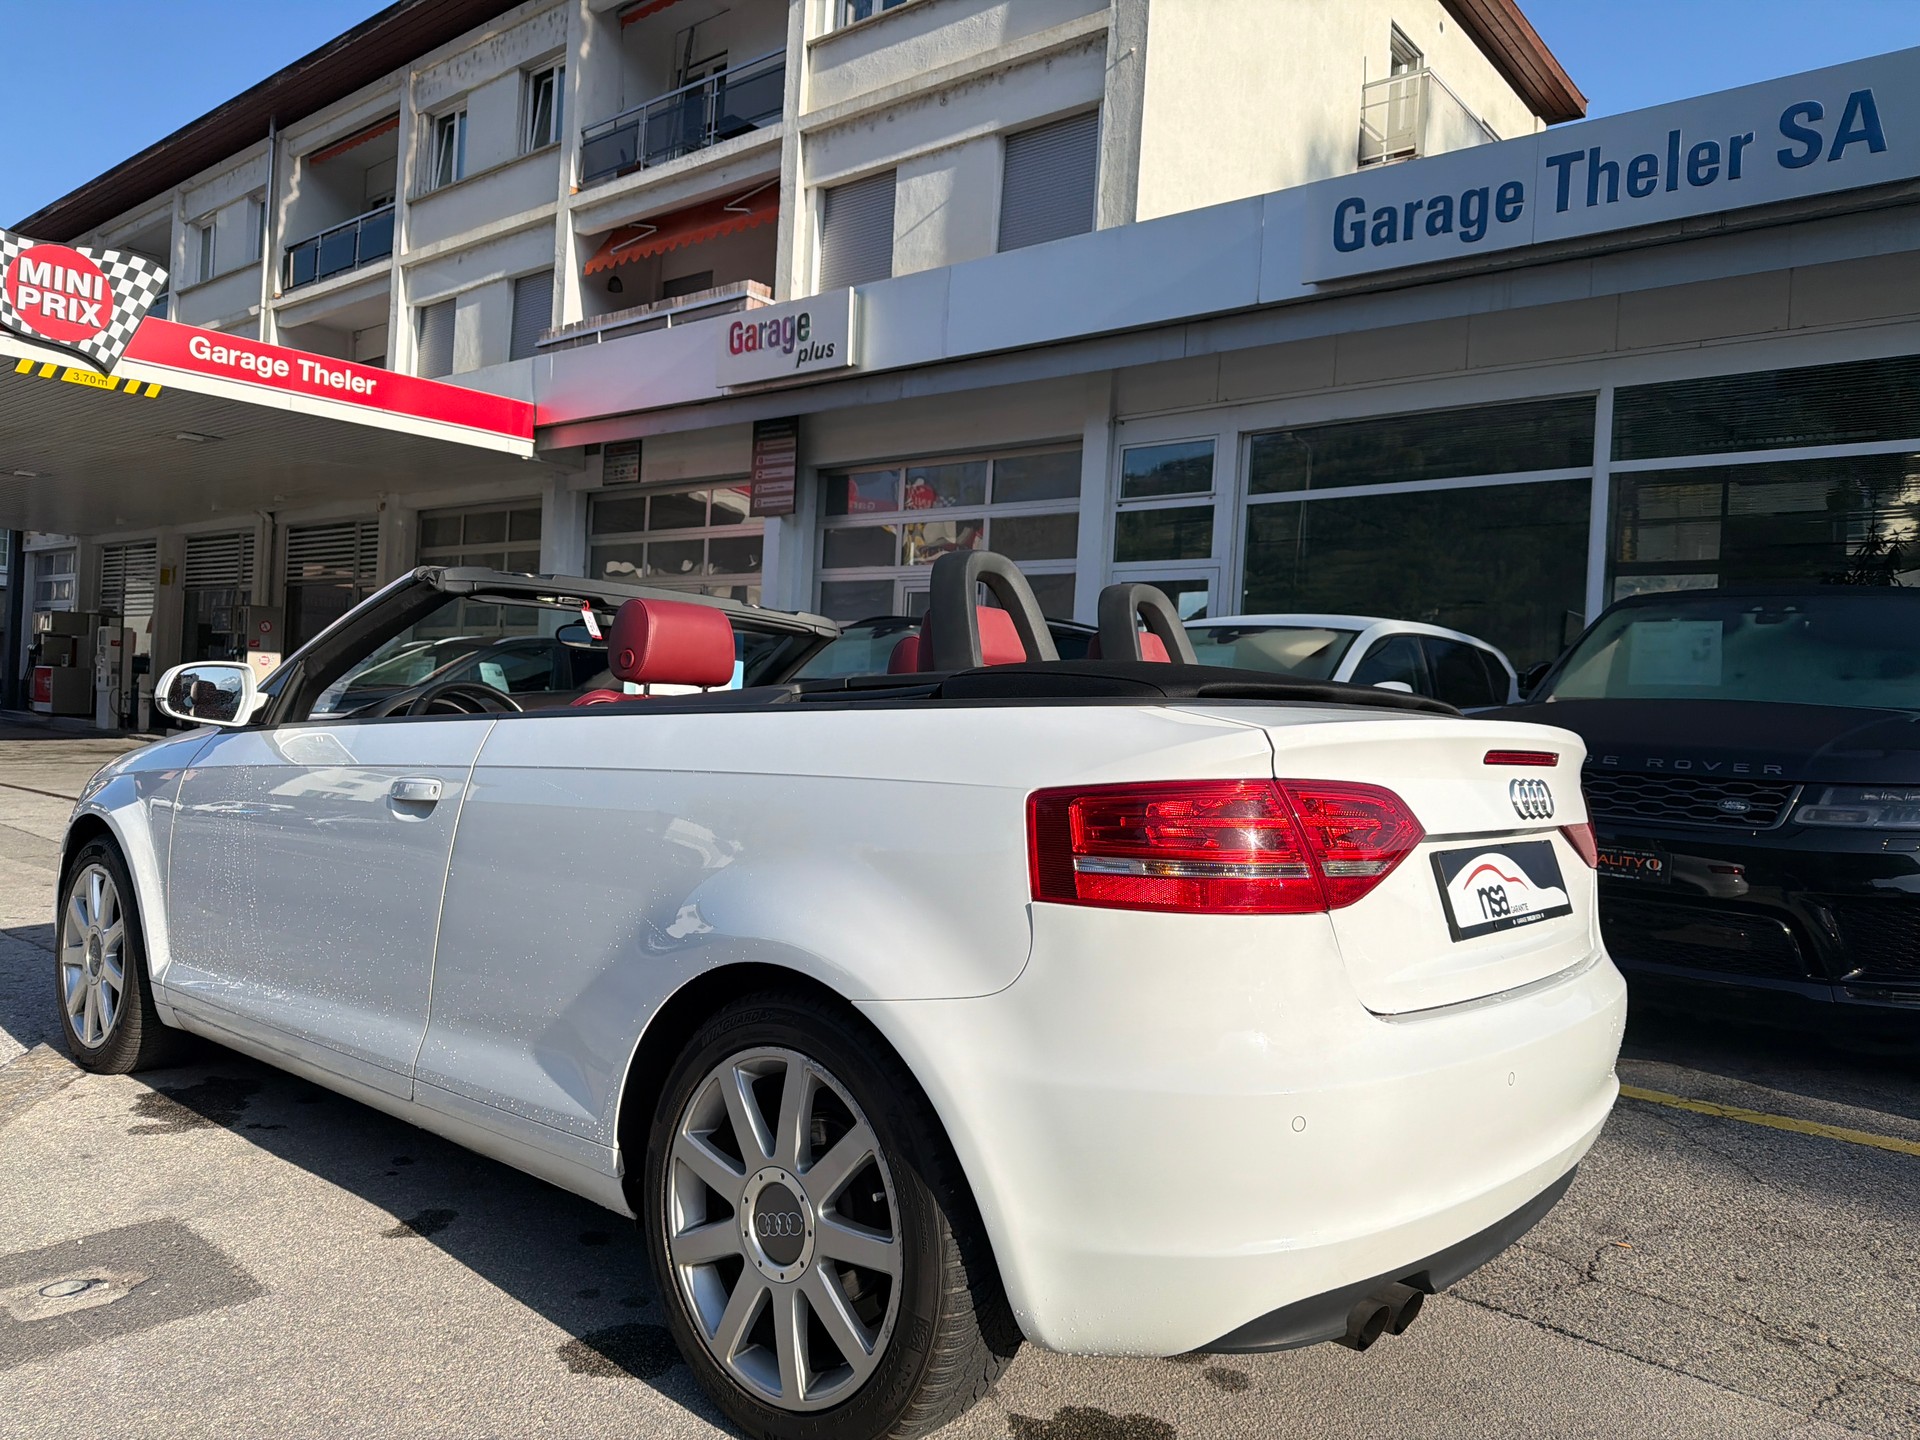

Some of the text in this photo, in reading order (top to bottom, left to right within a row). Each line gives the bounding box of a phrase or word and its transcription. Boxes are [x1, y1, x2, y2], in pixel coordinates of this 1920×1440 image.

[1332, 87, 1888, 253] Garage Theler SA
[18, 256, 104, 301] MINI
[16, 284, 103, 328] PRIX
[729, 312, 811, 356] Garage
[795, 341, 835, 368] plus
[188, 335, 377, 395] Garage Theler
[1585, 754, 1783, 775] GE ROVER
[1597, 854, 1647, 868] ALITY
[1476, 884, 1511, 920] nsa
